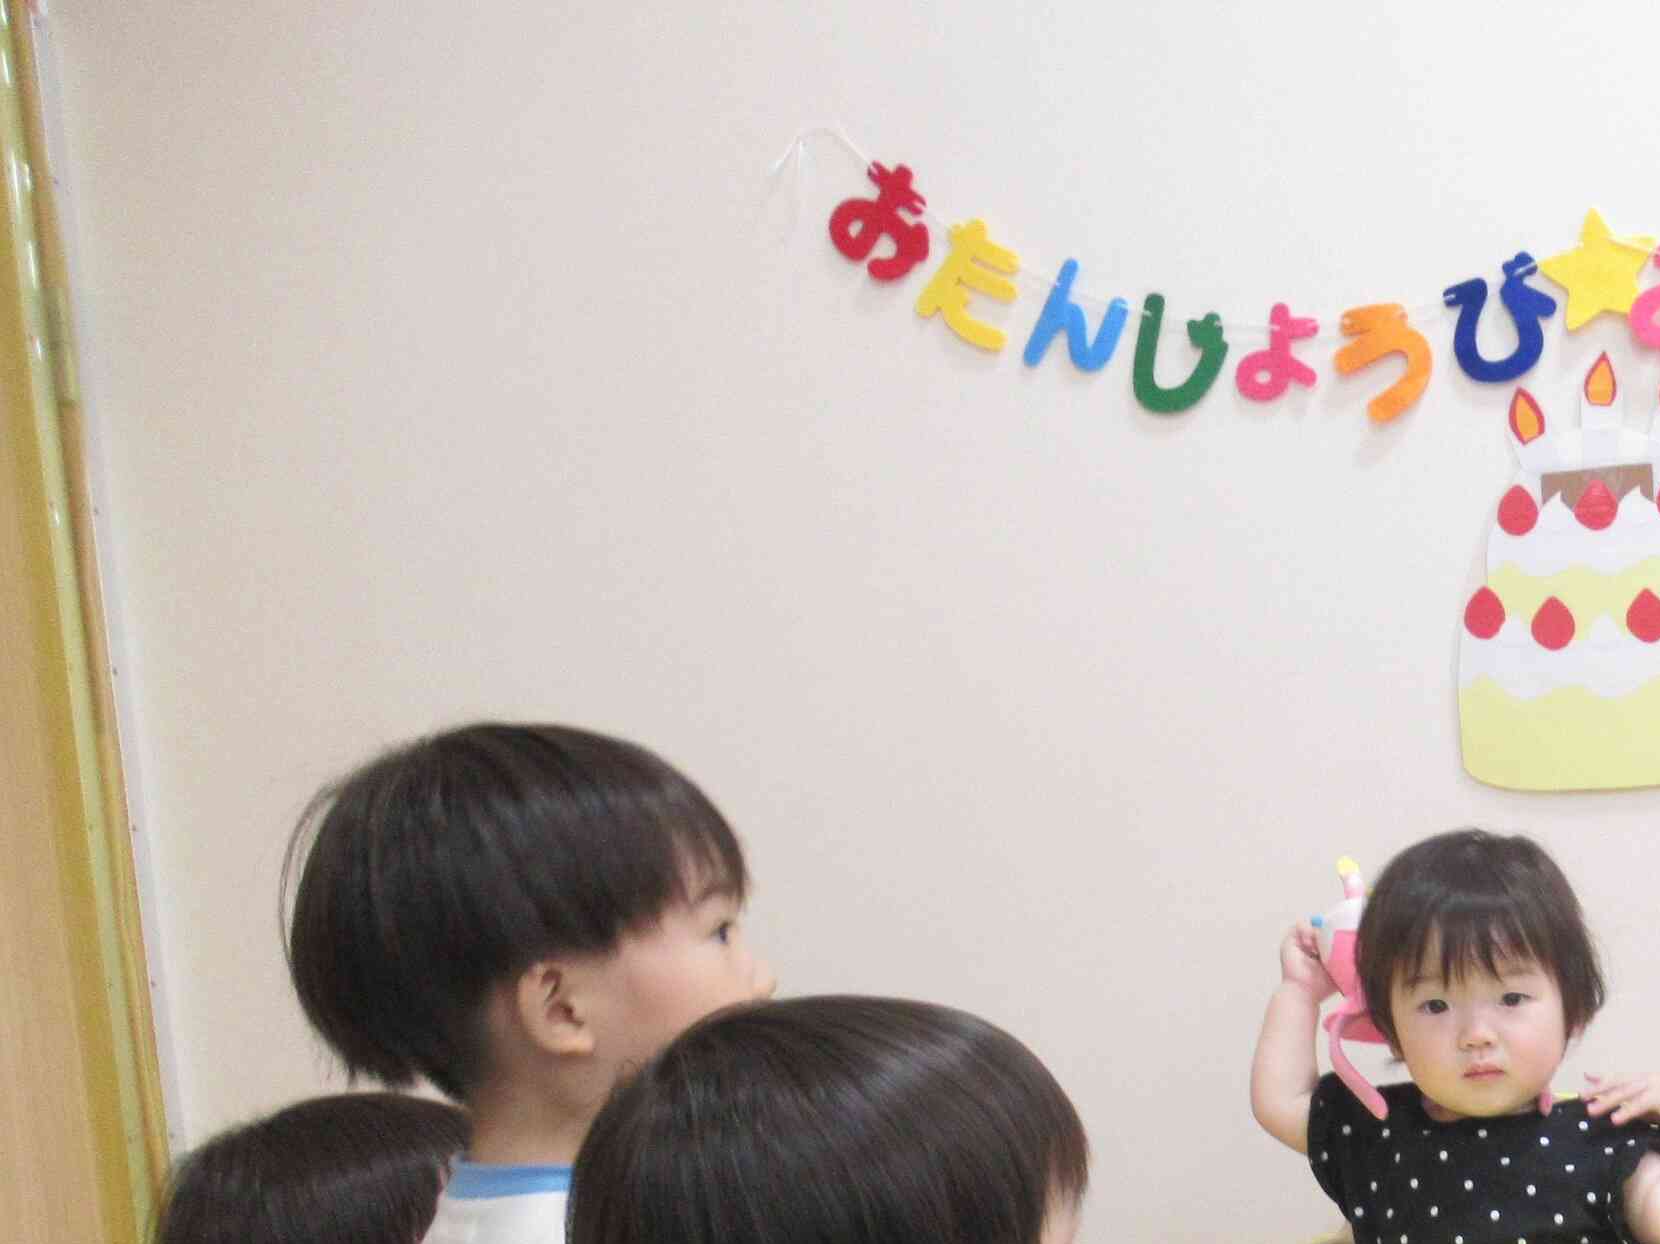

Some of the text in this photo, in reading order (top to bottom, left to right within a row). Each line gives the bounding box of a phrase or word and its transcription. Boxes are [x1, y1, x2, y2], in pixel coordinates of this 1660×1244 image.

[829, 160, 1557, 424] おたんじょうび
